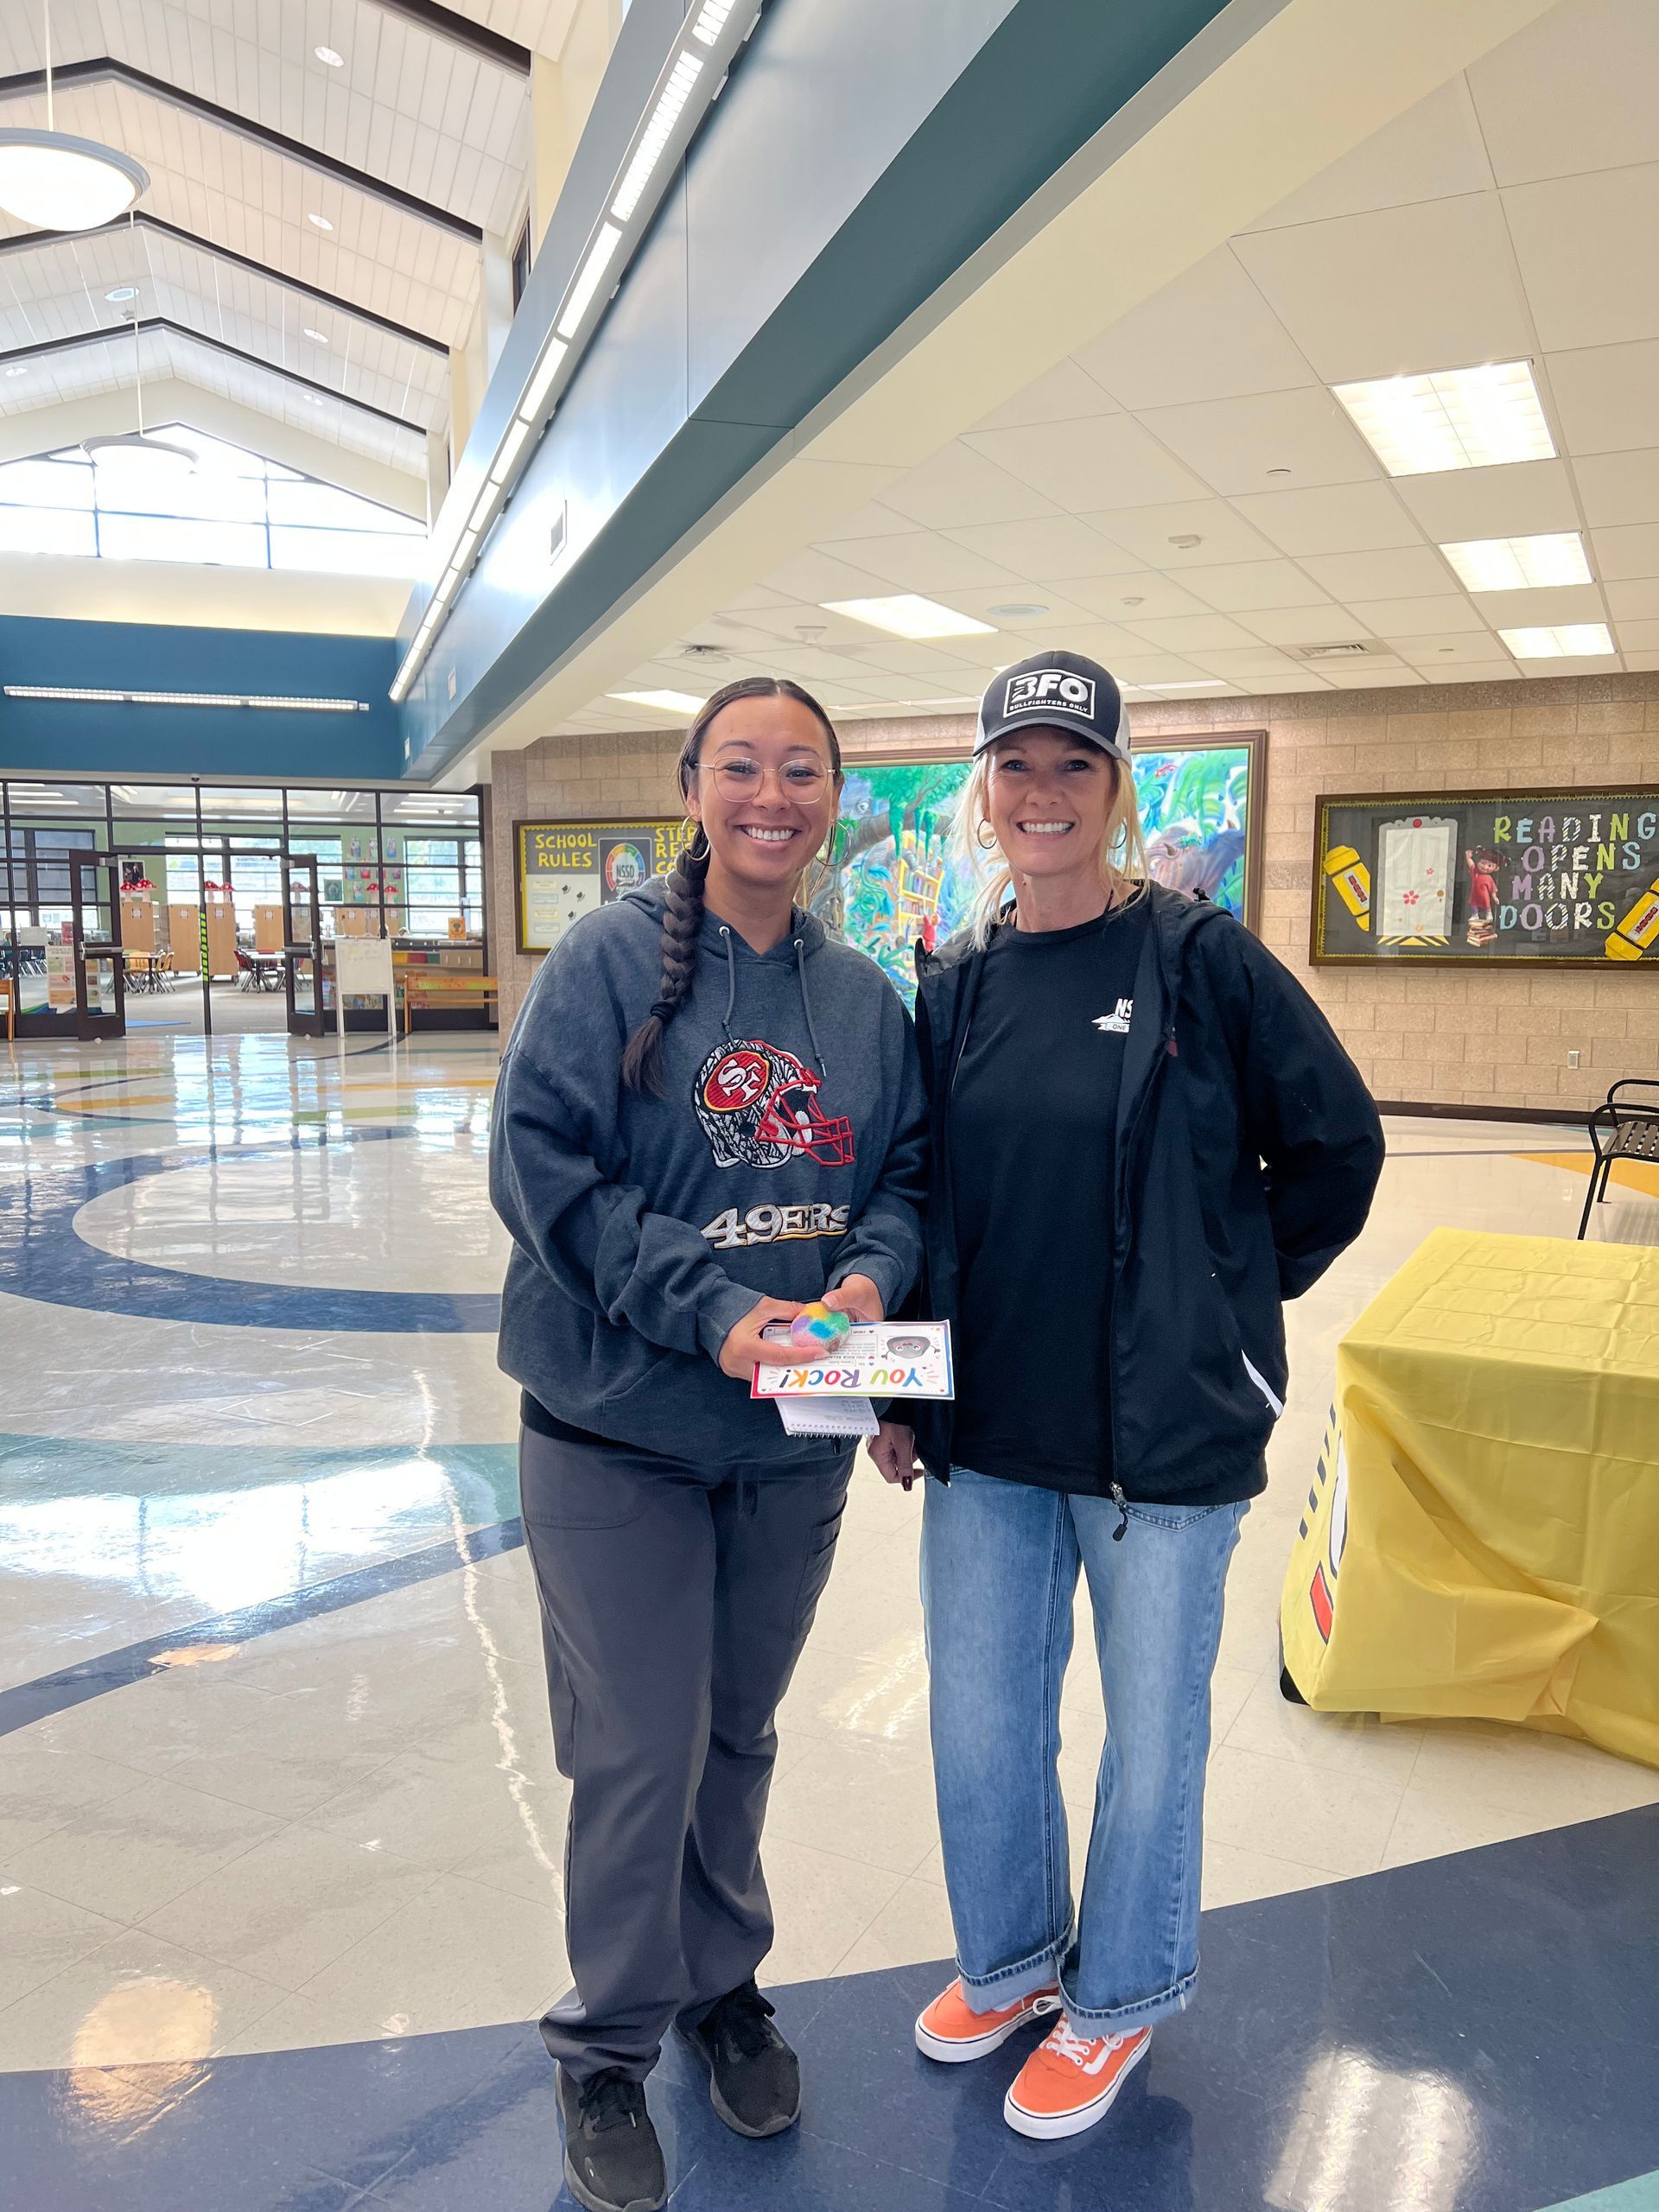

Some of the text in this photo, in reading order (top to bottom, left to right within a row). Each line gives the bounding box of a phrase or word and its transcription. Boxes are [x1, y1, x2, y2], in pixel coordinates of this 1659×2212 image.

[1009, 699, 1088, 713] BULLFIGHTERS ONLY
[535, 832, 597, 849] SCHOOL
[1493, 812, 1656, 844] READING
[538, 852, 593, 868] RULES
[1521, 841, 1641, 873] OPENS
[616, 864, 635, 878] NSSD
[1512, 872, 1604, 900] MANY
[1499, 901, 1616, 930] DOORS
[700, 1202, 850, 1249] 49ERS
[779, 1367, 923, 1389] YOU ROCK!
